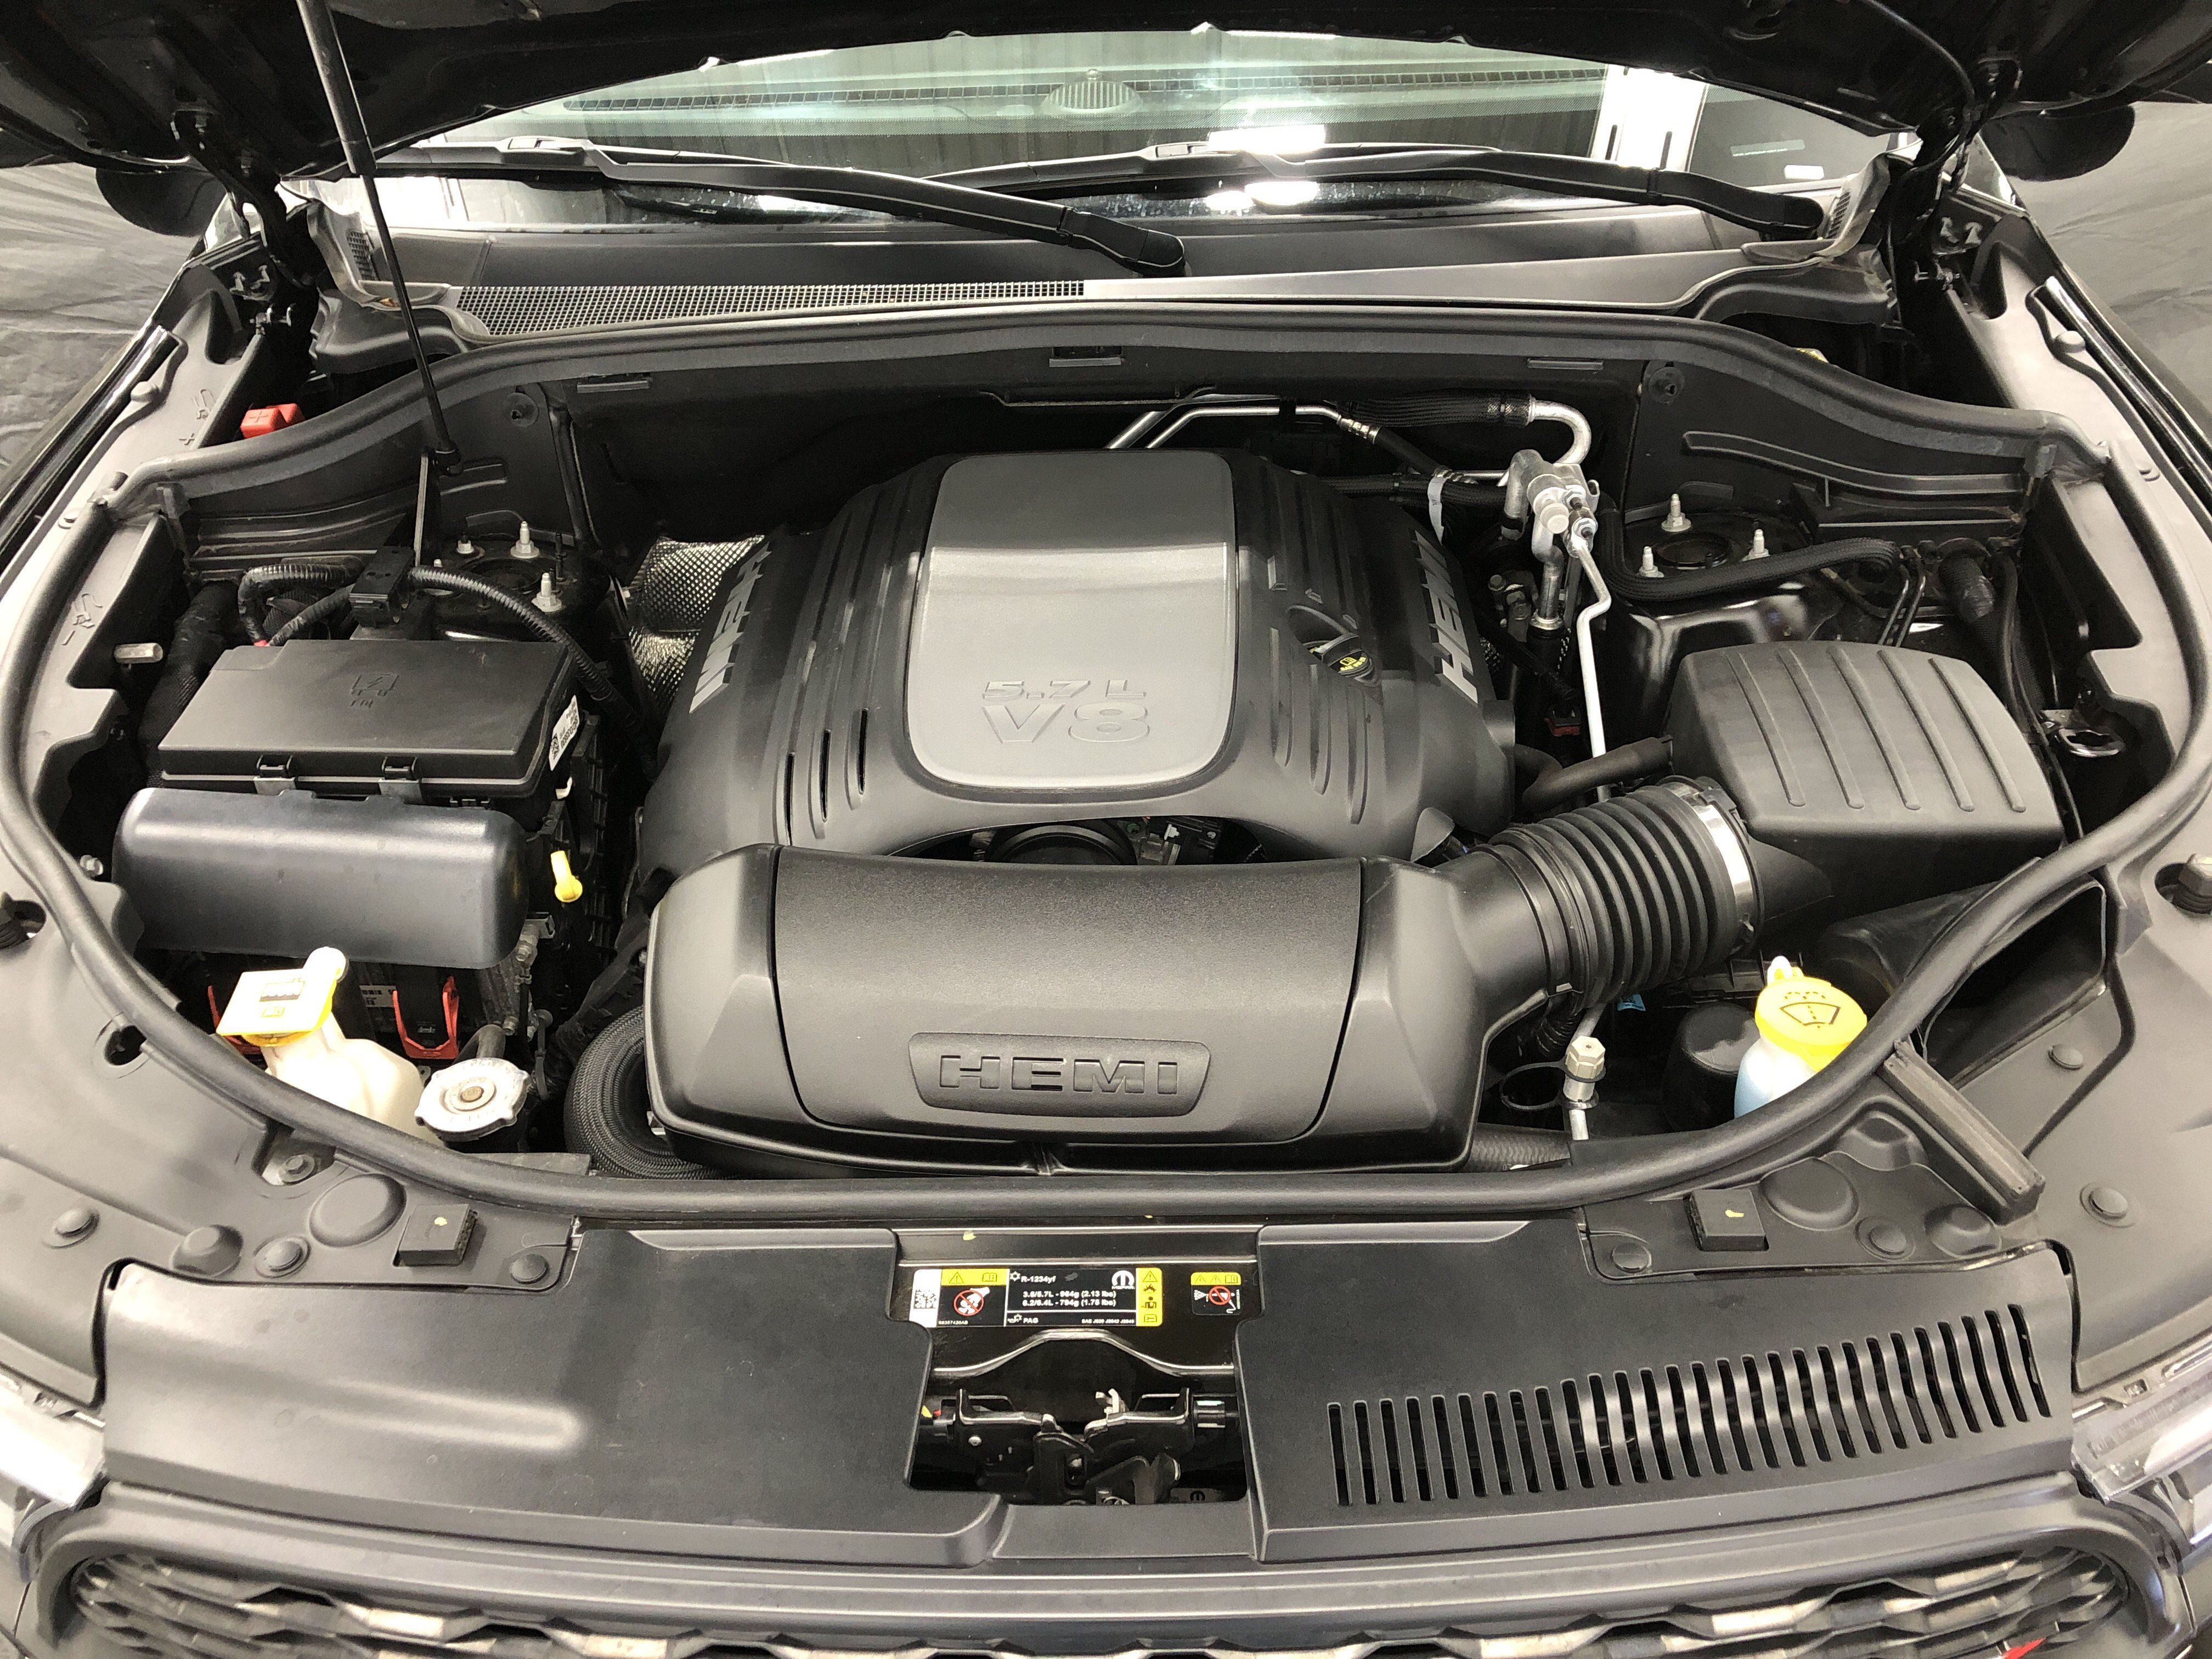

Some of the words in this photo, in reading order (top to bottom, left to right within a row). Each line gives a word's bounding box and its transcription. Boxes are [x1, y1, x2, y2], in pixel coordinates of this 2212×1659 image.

[1414, 529, 1479, 704] HEMI
[981, 702, 1150, 743] V8
[939, 1055, 1178, 1095] HEMI
[1021, 1276, 1056, 1284] R-1234yf
[1081, 1290, 1100, 1299] (2.13
[1102, 1290, 1116, 1299] lbs)
[1102, 1299, 1116, 1307] lbs)
